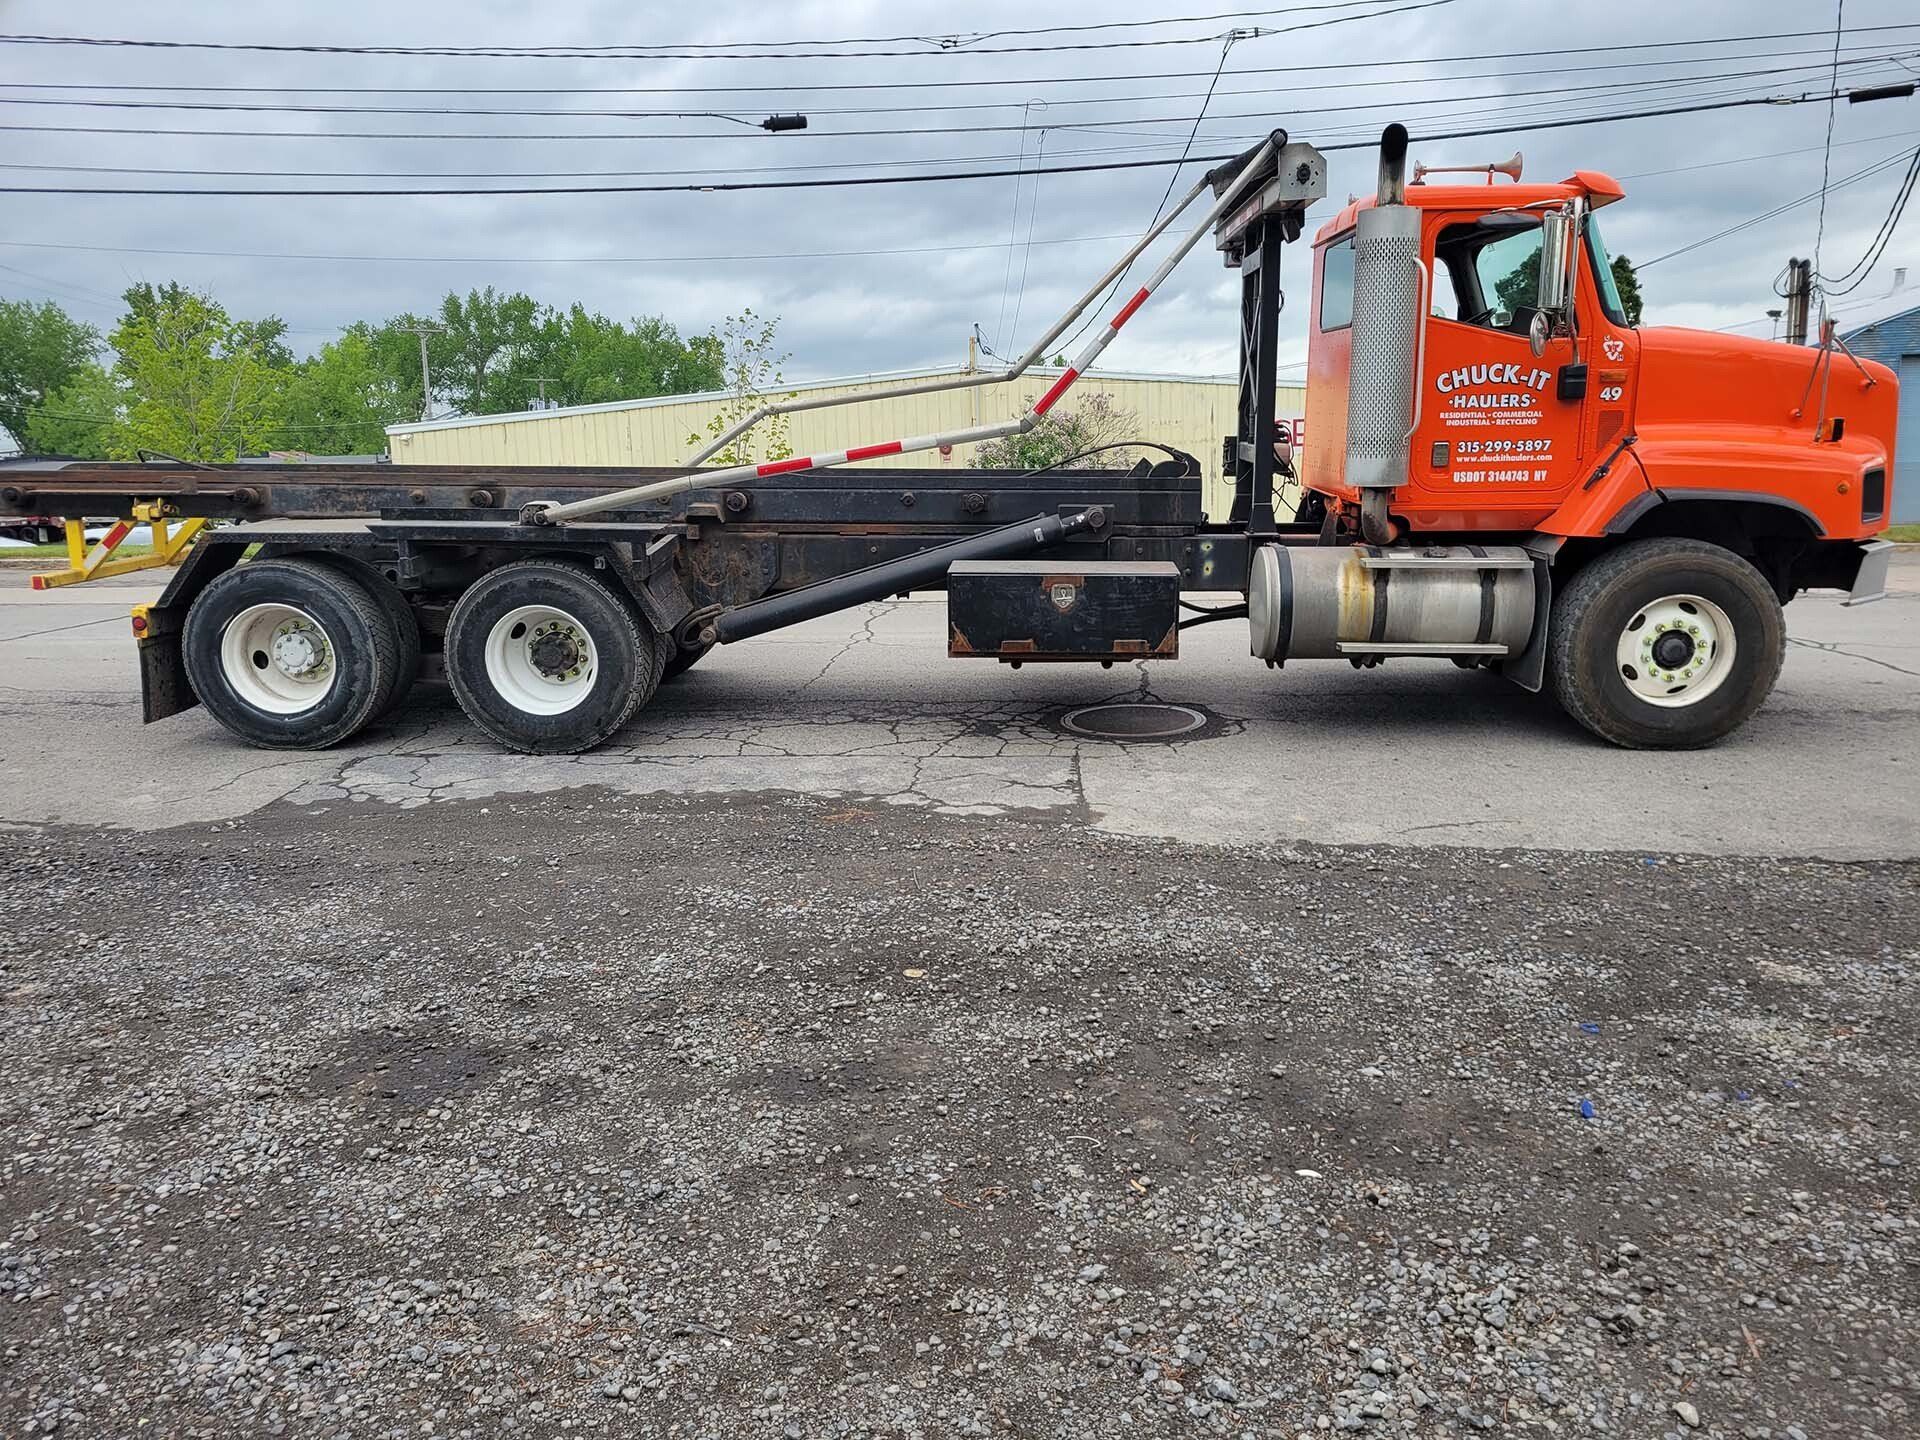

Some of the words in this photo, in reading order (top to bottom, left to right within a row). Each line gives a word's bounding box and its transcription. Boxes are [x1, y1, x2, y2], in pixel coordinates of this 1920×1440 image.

[1436, 363, 1551, 393] CHUCK-IT
[1599, 386, 1622, 401] 49
[1440, 411, 1487, 419] RESIDENTIAL
[1492, 411, 1543, 419] COMMERCIAL
[1456, 453, 1552, 463] www.chuckithaulers.com
[1453, 471, 1485, 482] USDOT
[1488, 470, 1529, 482] 3144743
